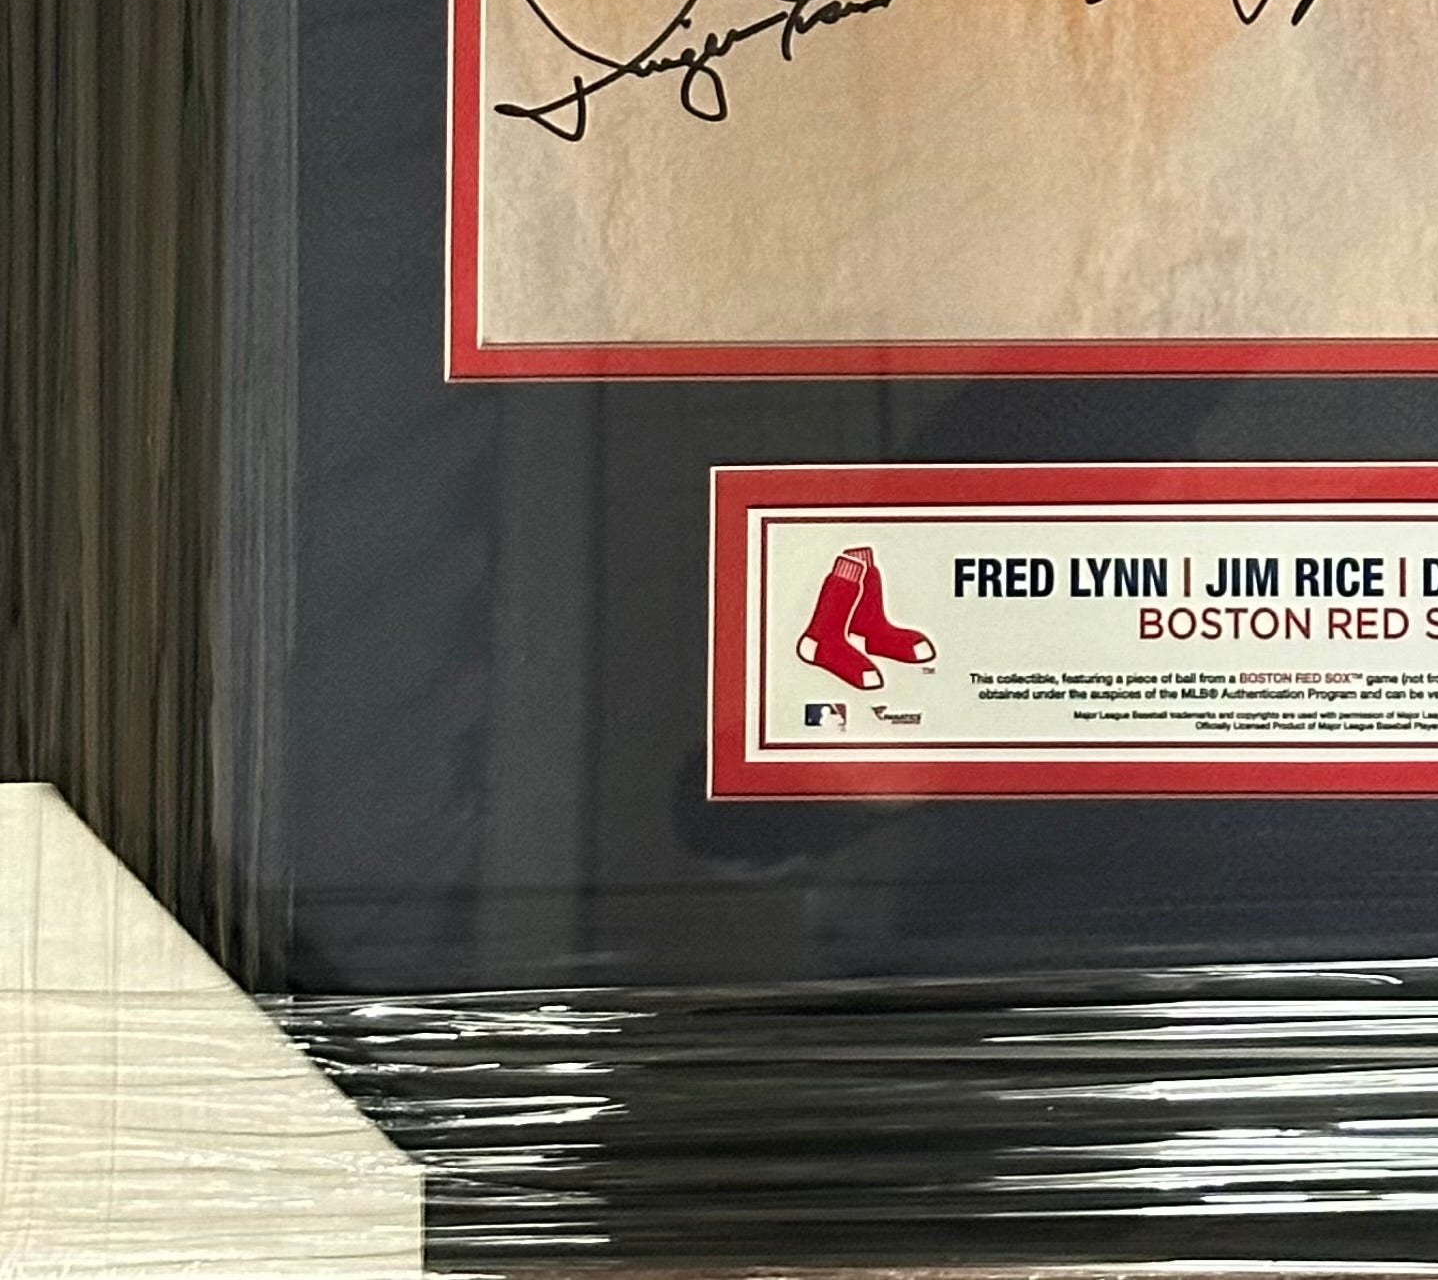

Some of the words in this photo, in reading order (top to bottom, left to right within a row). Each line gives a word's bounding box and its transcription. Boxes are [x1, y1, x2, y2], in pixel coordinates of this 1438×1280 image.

[954, 558, 1055, 598] FRED
[1070, 557, 1168, 598] LYNN
[1205, 557, 1279, 598] JIM
[1295, 557, 1385, 598] RICE
[1139, 606, 1311, 640] BOSTON
[1328, 607, 1410, 640] RED
[968, 672, 995, 684] This
[996, 673, 1060, 687] collectible,
[1061, 672, 1114, 687] featuring
[1115, 674, 1124, 684] a
[1125, 675, 1158, 687] piece
[1160, 672, 1173, 684] of
[1175, 672, 1197, 684] ball
[1198, 672, 1227, 684] from
[1228, 674, 1237, 684] a
[1239, 672, 1292, 684] BOSTON
[1295, 672, 1322, 684] RED
[1365, 675, 1399, 687] game
[1401, 672, 1425, 687] (not
[978, 688, 1030, 700] obtained
[1031, 688, 1067, 700] under
[1068, 688, 1088, 700] the
[1089, 690, 1142, 702] auspices
[1144, 688, 1157, 700] of
[1158, 688, 1179, 700] the
[1220, 688, 1305, 700] Authentication
[1307, 688, 1358, 702] Program
[1359, 688, 1383, 700] and
[1384, 690, 1407, 700] can
[1409, 688, 1425, 700] be
